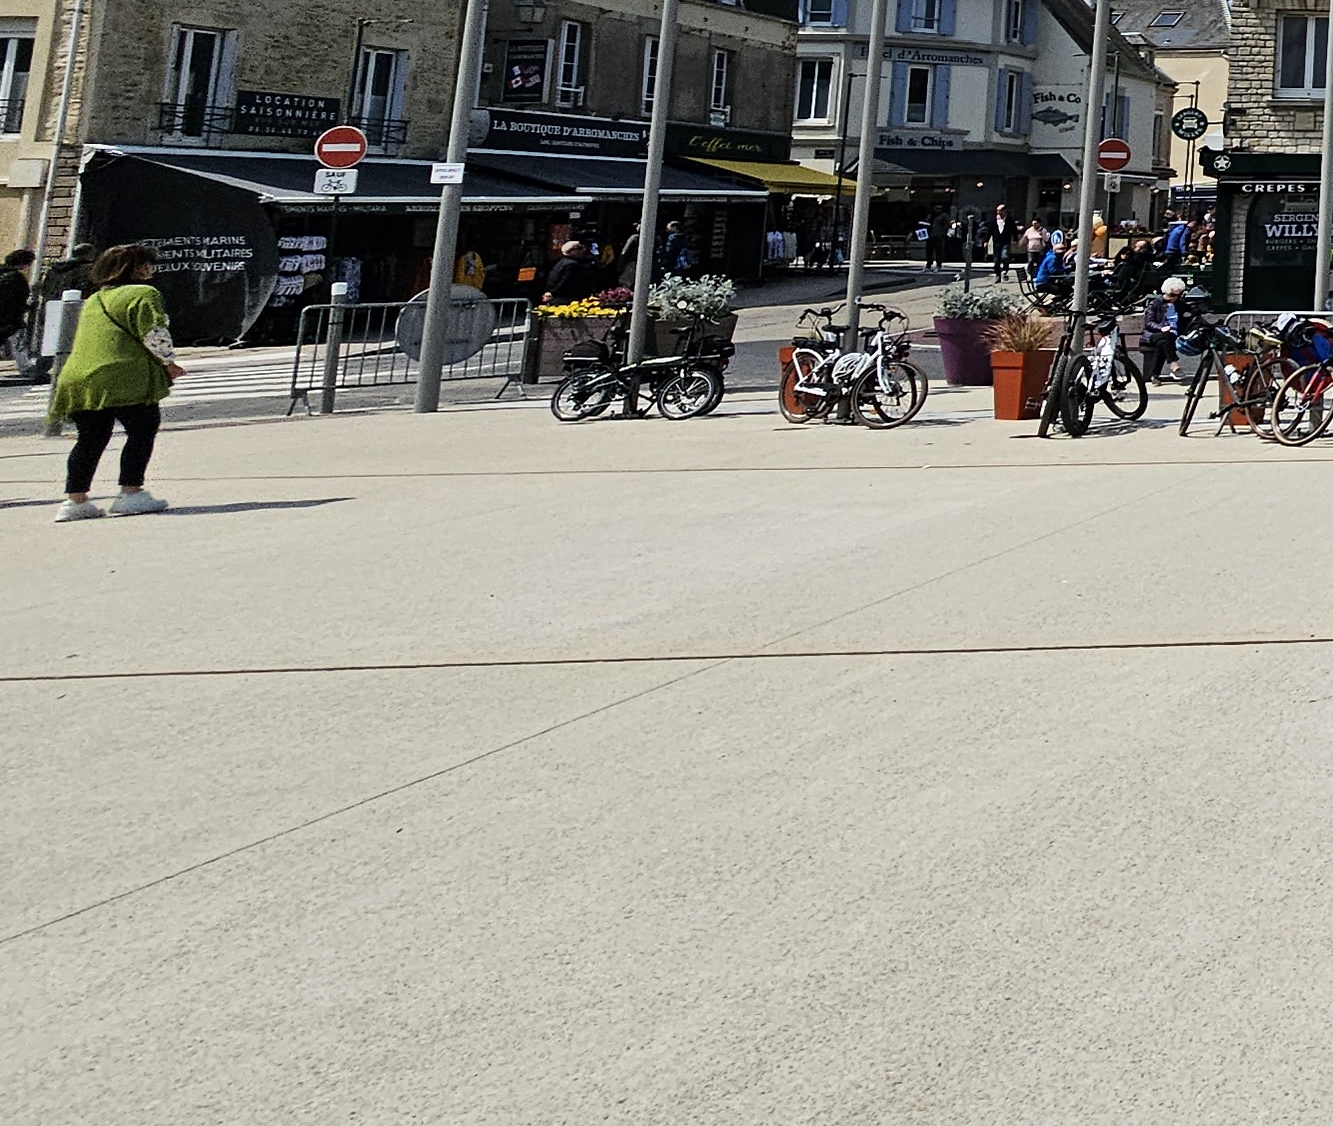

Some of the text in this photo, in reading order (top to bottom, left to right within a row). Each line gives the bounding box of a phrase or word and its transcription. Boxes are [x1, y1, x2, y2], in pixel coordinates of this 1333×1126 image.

[898, 49, 983, 64] d'Arromanches
[255, 95, 326, 108] LOCATION
[1033, 91, 1081, 104] Fish & Co
[240, 105, 336, 121] SAISONNIÈRE
[493, 120, 640, 142] LA BOUTIQUE D'ARROMANCHES
[737, 143, 762, 153] mer
[878, 135, 954, 149] Fish & Chips
[1241, 184, 1305, 193] CREPES
[1273, 214, 1319, 222] SERGEN
